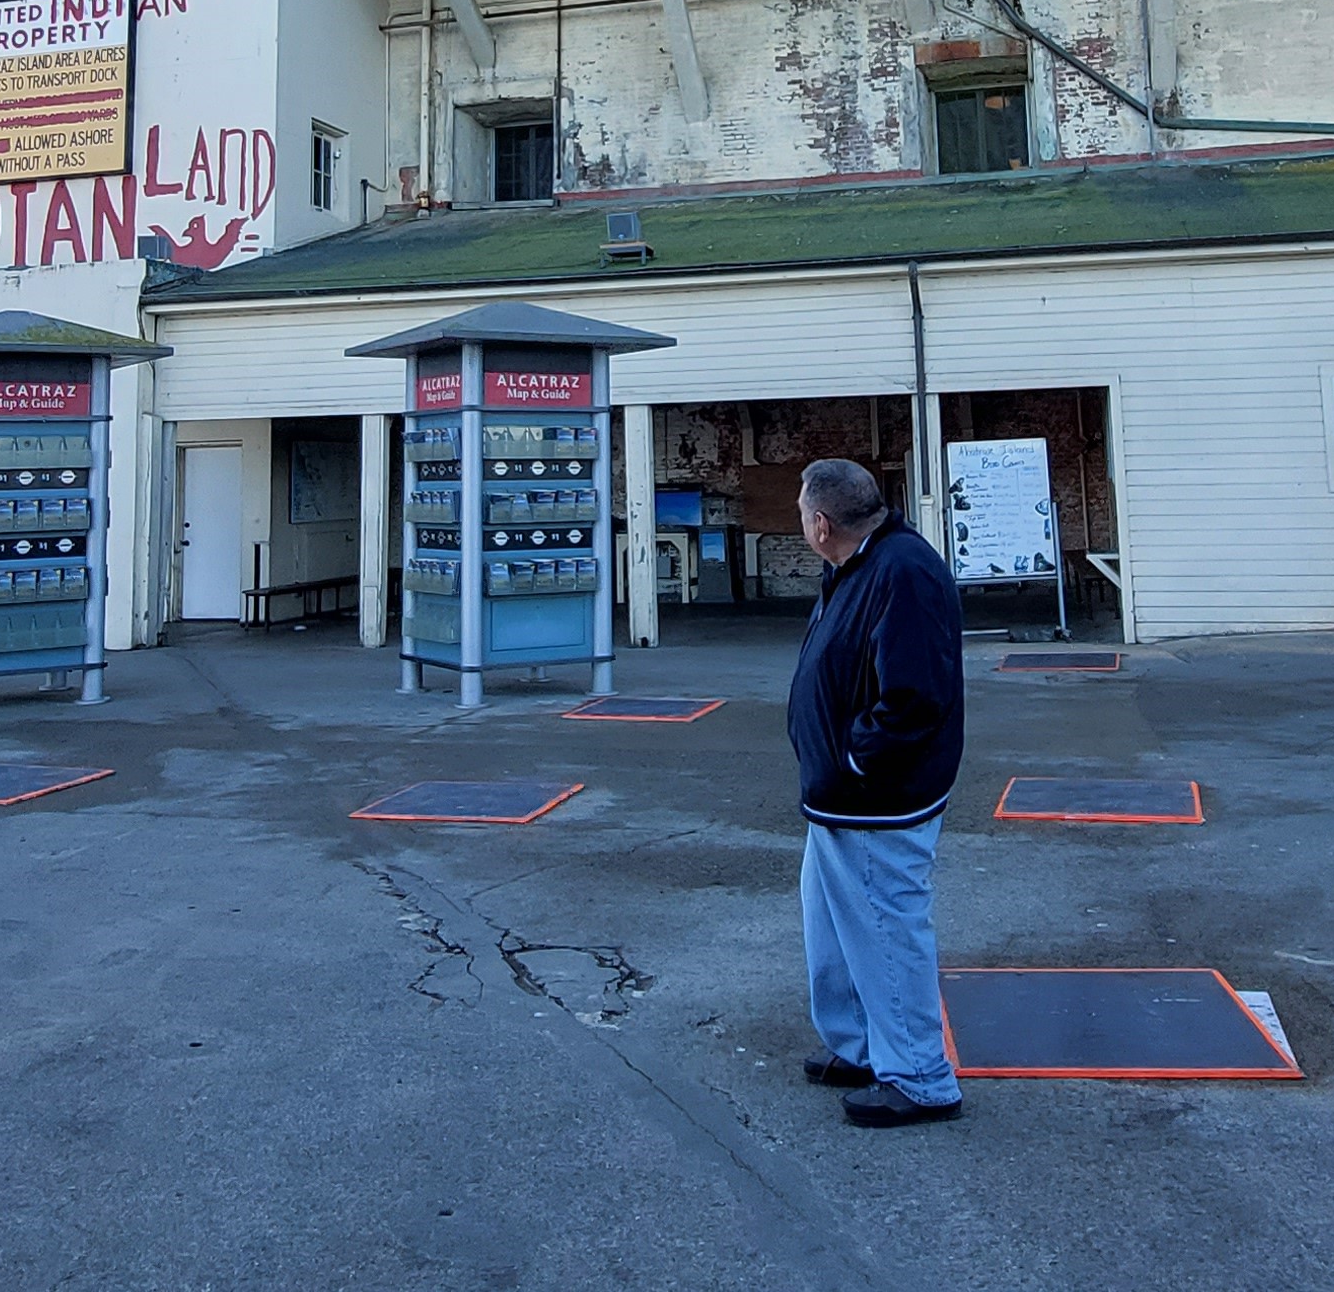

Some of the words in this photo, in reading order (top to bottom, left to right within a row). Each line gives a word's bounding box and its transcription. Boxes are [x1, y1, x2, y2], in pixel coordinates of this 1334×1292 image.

[17, 54, 52, 72] ISLAND
[54, 51, 80, 68] AREA
[83, 50, 93, 65] 12
[94, 46, 125, 64] ACRES
[10, 76, 24, 90] TO
[27, 70, 87, 89] TRANSPORT
[90, 66, 118, 83] DOCK
[14, 132, 67, 152] ALLOWED
[69, 128, 114, 147] ASHORE
[44, 155, 51, 170] A
[56, 151, 86, 169] PASS
[421, 375, 461, 392] ALCATRAZ
[496, 374, 580, 388] ALCATRAZ
[19, 398, 28, 409] &
[31, 398, 66, 409] Guide
[507, 388, 530, 401] Map
[530, 389, 540, 399] &
[541, 389, 571, 400] Guide
